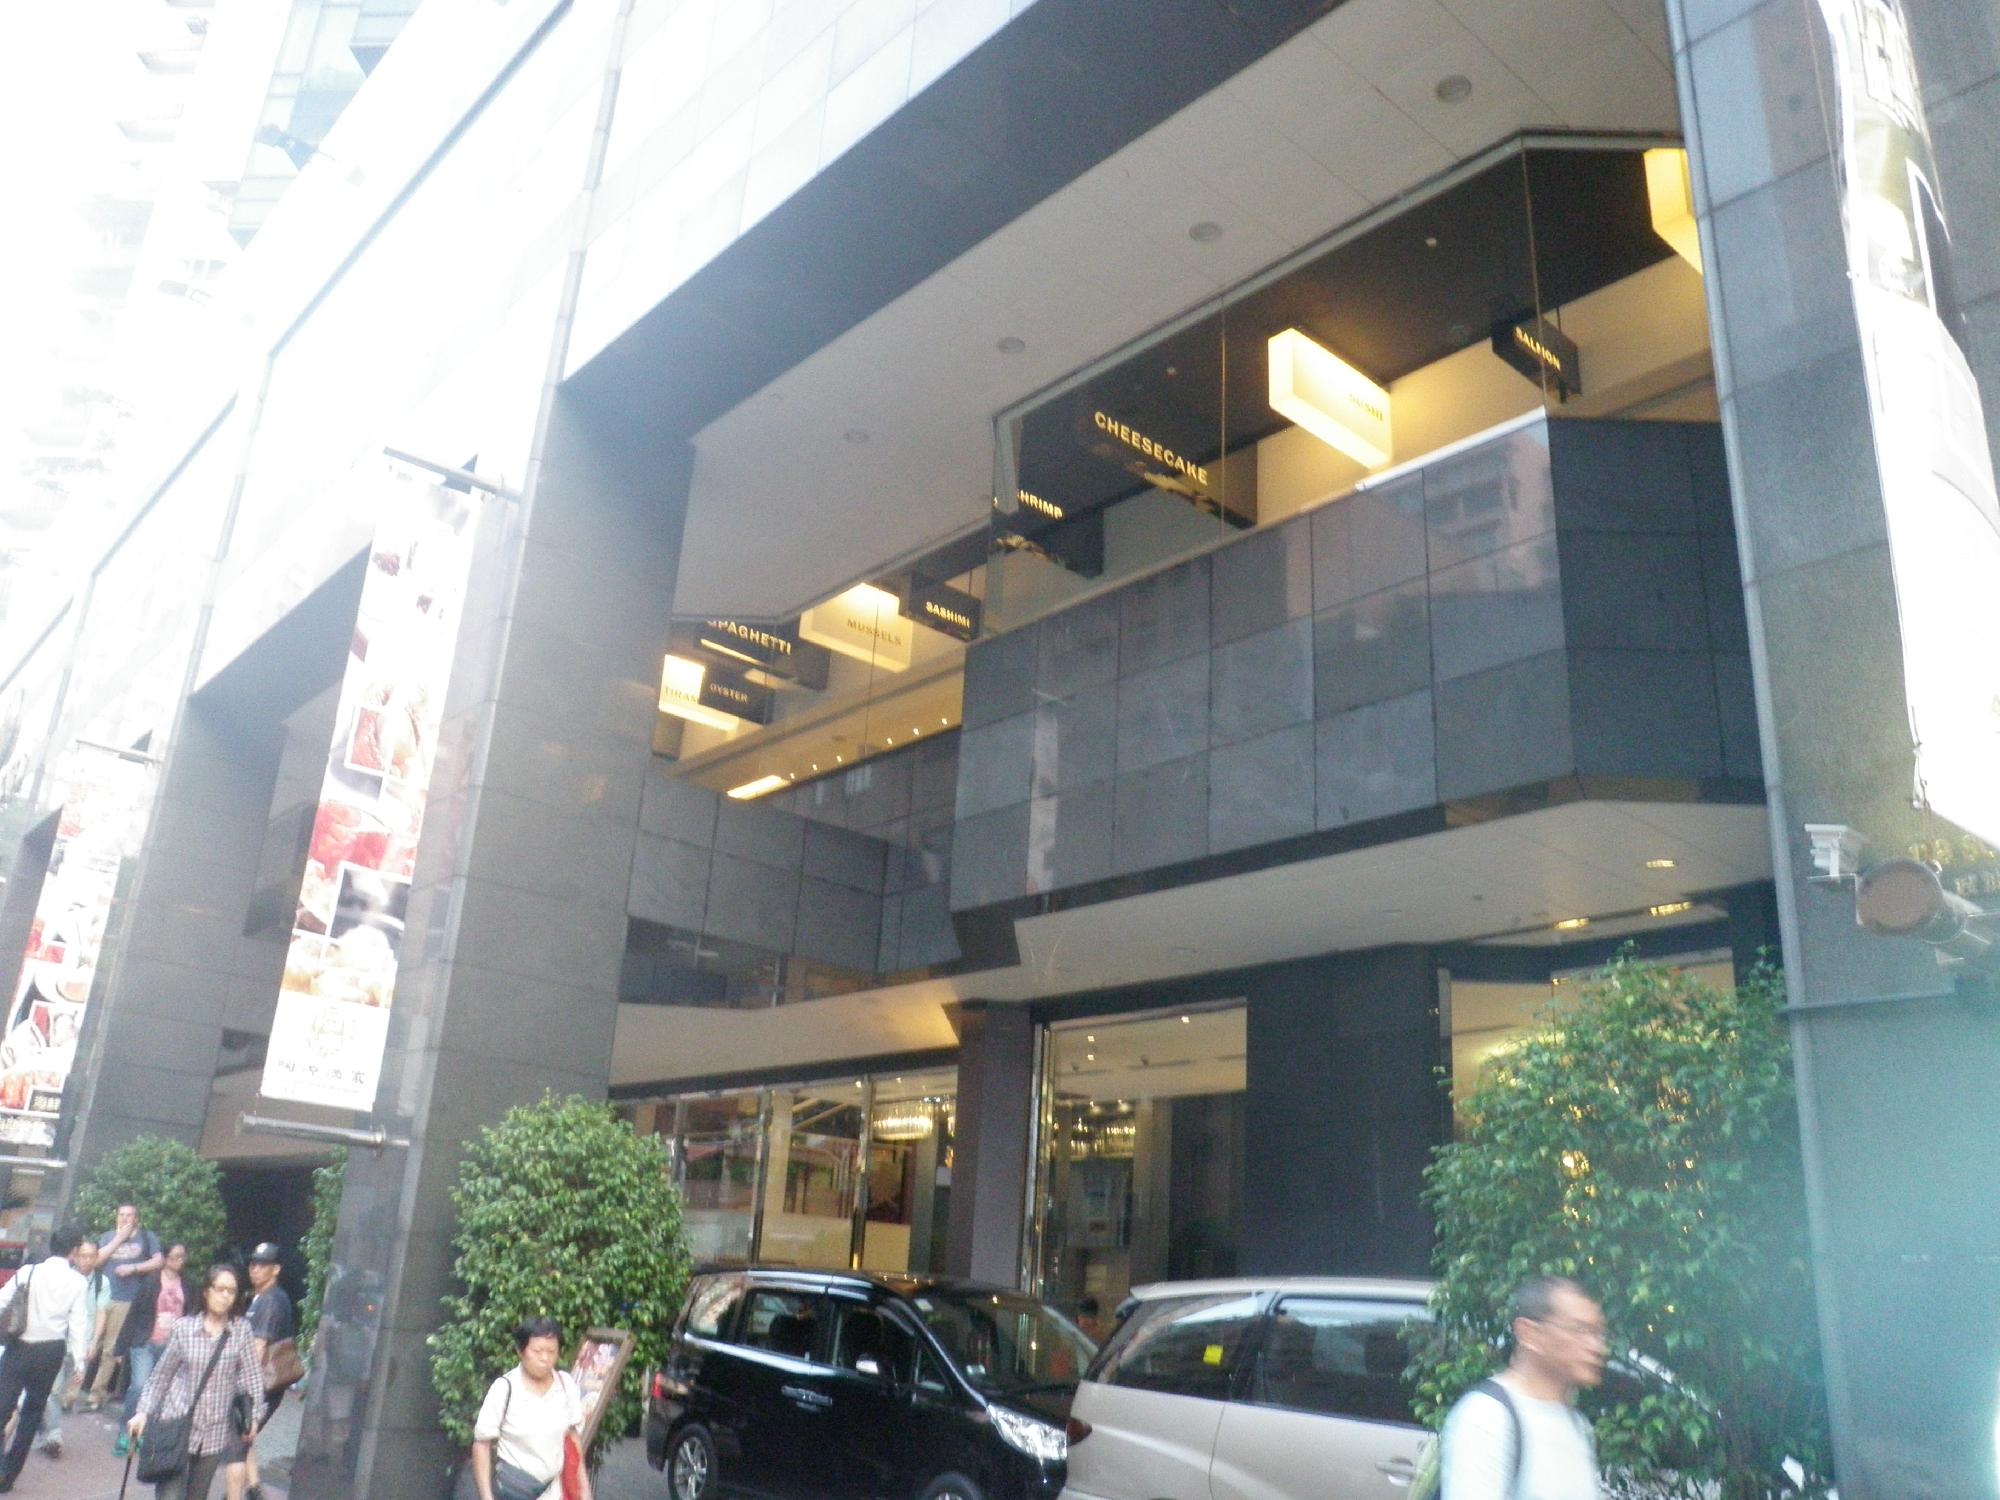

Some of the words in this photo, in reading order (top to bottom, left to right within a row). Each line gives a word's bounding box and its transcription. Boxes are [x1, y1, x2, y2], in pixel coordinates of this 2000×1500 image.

[1348, 392, 1384, 424] SUSHI
[1094, 410, 1208, 486] CHEESECAKE
[1017, 489, 1063, 520] HRIMP
[925, 600, 971, 628] SASHIMI
[847, 617, 902, 647] MUSSELS
[709, 683, 748, 705] OYSTER
